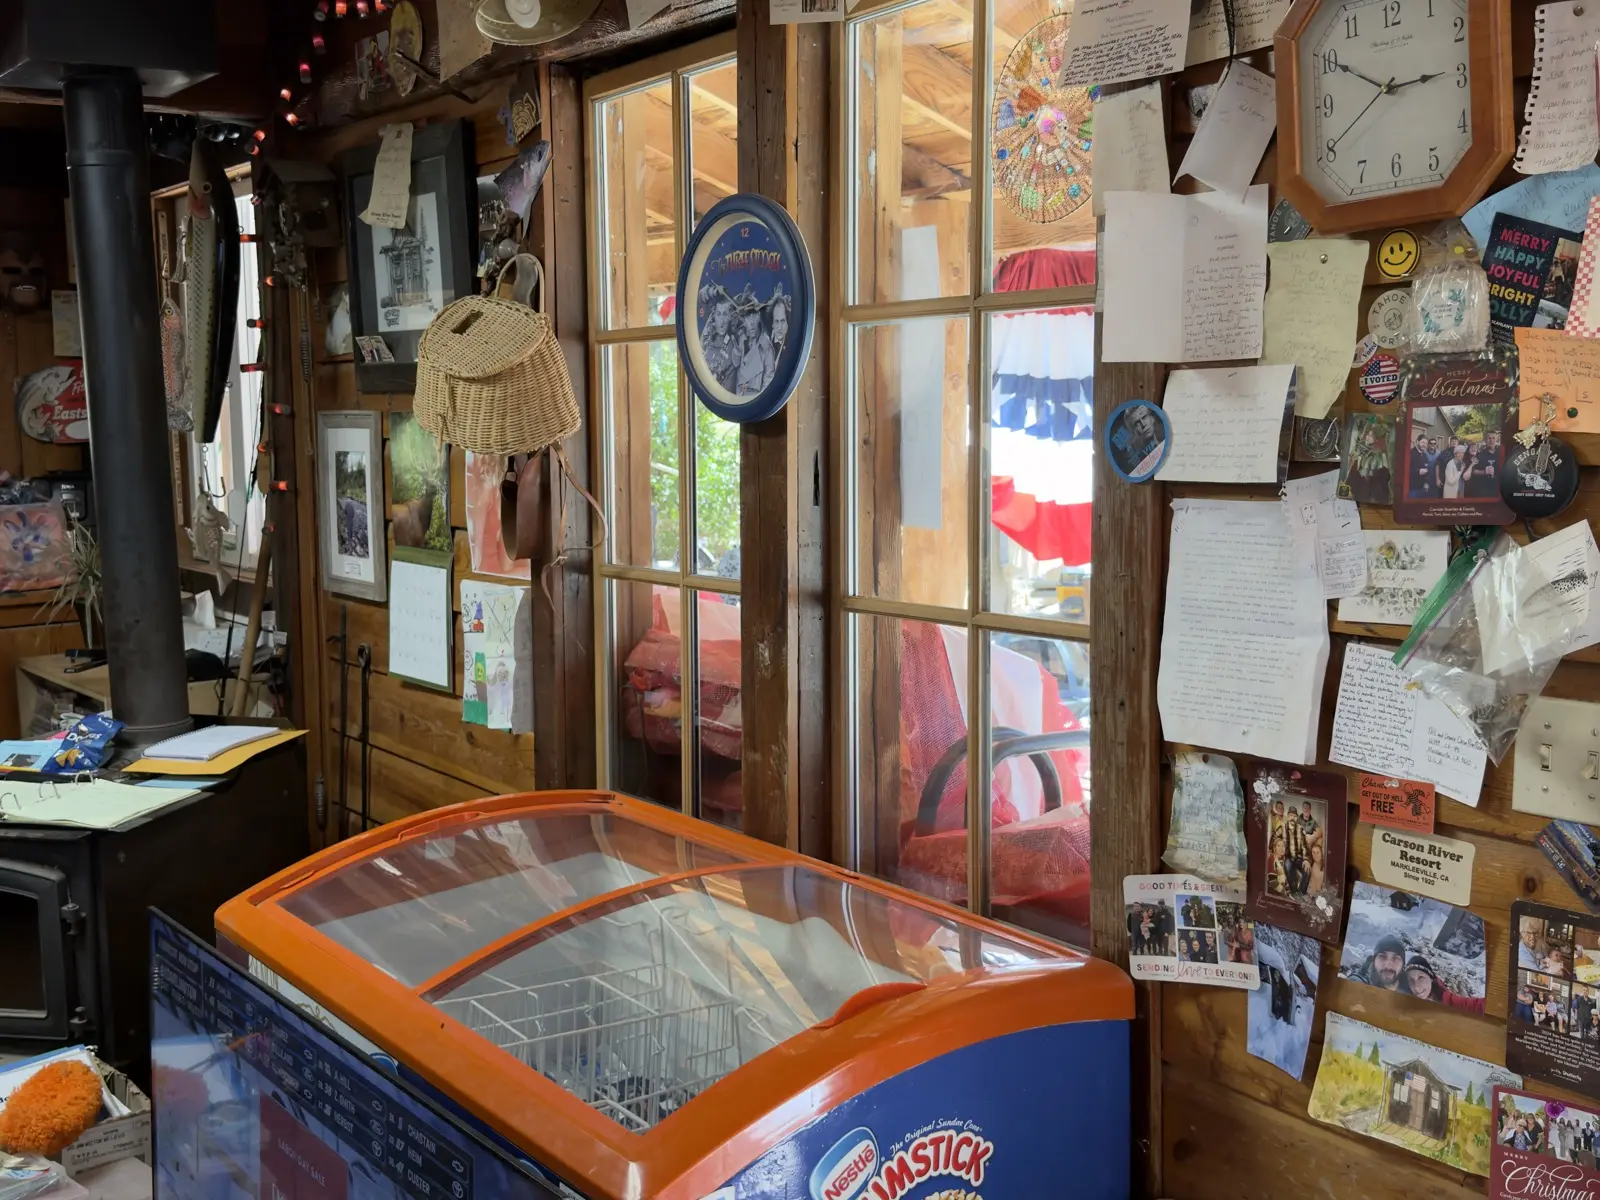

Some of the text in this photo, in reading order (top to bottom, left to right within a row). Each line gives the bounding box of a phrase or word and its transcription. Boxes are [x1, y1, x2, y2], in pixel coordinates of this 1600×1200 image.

[1344, 13, 1359, 39] 11
[1382, 0, 1401, 29] 12
[1453, 16, 1465, 43] 2
[1321, 48, 1338, 75] 10
[1456, 62, 1468, 88] 3
[1323, 93, 1334, 118] 9
[1457, 108, 1469, 134] 4
[1326, 138, 1337, 163] 8
[1428, 146, 1440, 171] 5
[1357, 159, 1368, 184] 7
[1391, 153, 1402, 178] 6
[1500, 228, 1550, 252] MERRY
[1494, 245, 1546, 270] HAPPY
[1487, 263, 1540, 289] JOYFUL
[1372, 293, 1407, 315] TAHOE
[1490, 301, 1530, 323] OLLY
[1363, 342, 1378, 358] Voted
[1364, 374, 1398, 385] I VOTED
[1411, 374, 1506, 398] christmas
[53, 405, 88, 421] Easts
[1361, 790, 1371, 798] GET
[1372, 791, 1383, 799] OUT
[1370, 799, 1395, 815] FREE
[1381, 832, 1463, 863] Carson River
[1399, 849, 1442, 870] Resort
[1390, 860, 1449, 882] MARKLEEVILLE, CA
[1403, 871, 1420, 882] Since
[1139, 881, 1166, 891] GOOD
[1200, 883, 1224, 895] GREAT
[1137, 963, 1175, 973] SENDING
[1203, 968, 1214, 976] TO
[407, 1124, 436, 1155] CHASTAIN
[889, 1116, 981, 1157] The Original Sundae Cone
[1503, 1151, 1529, 1161] MERRY
[407, 1168, 431, 1197] CUSTER
[824, 1143, 876, 1200] Nestlé
